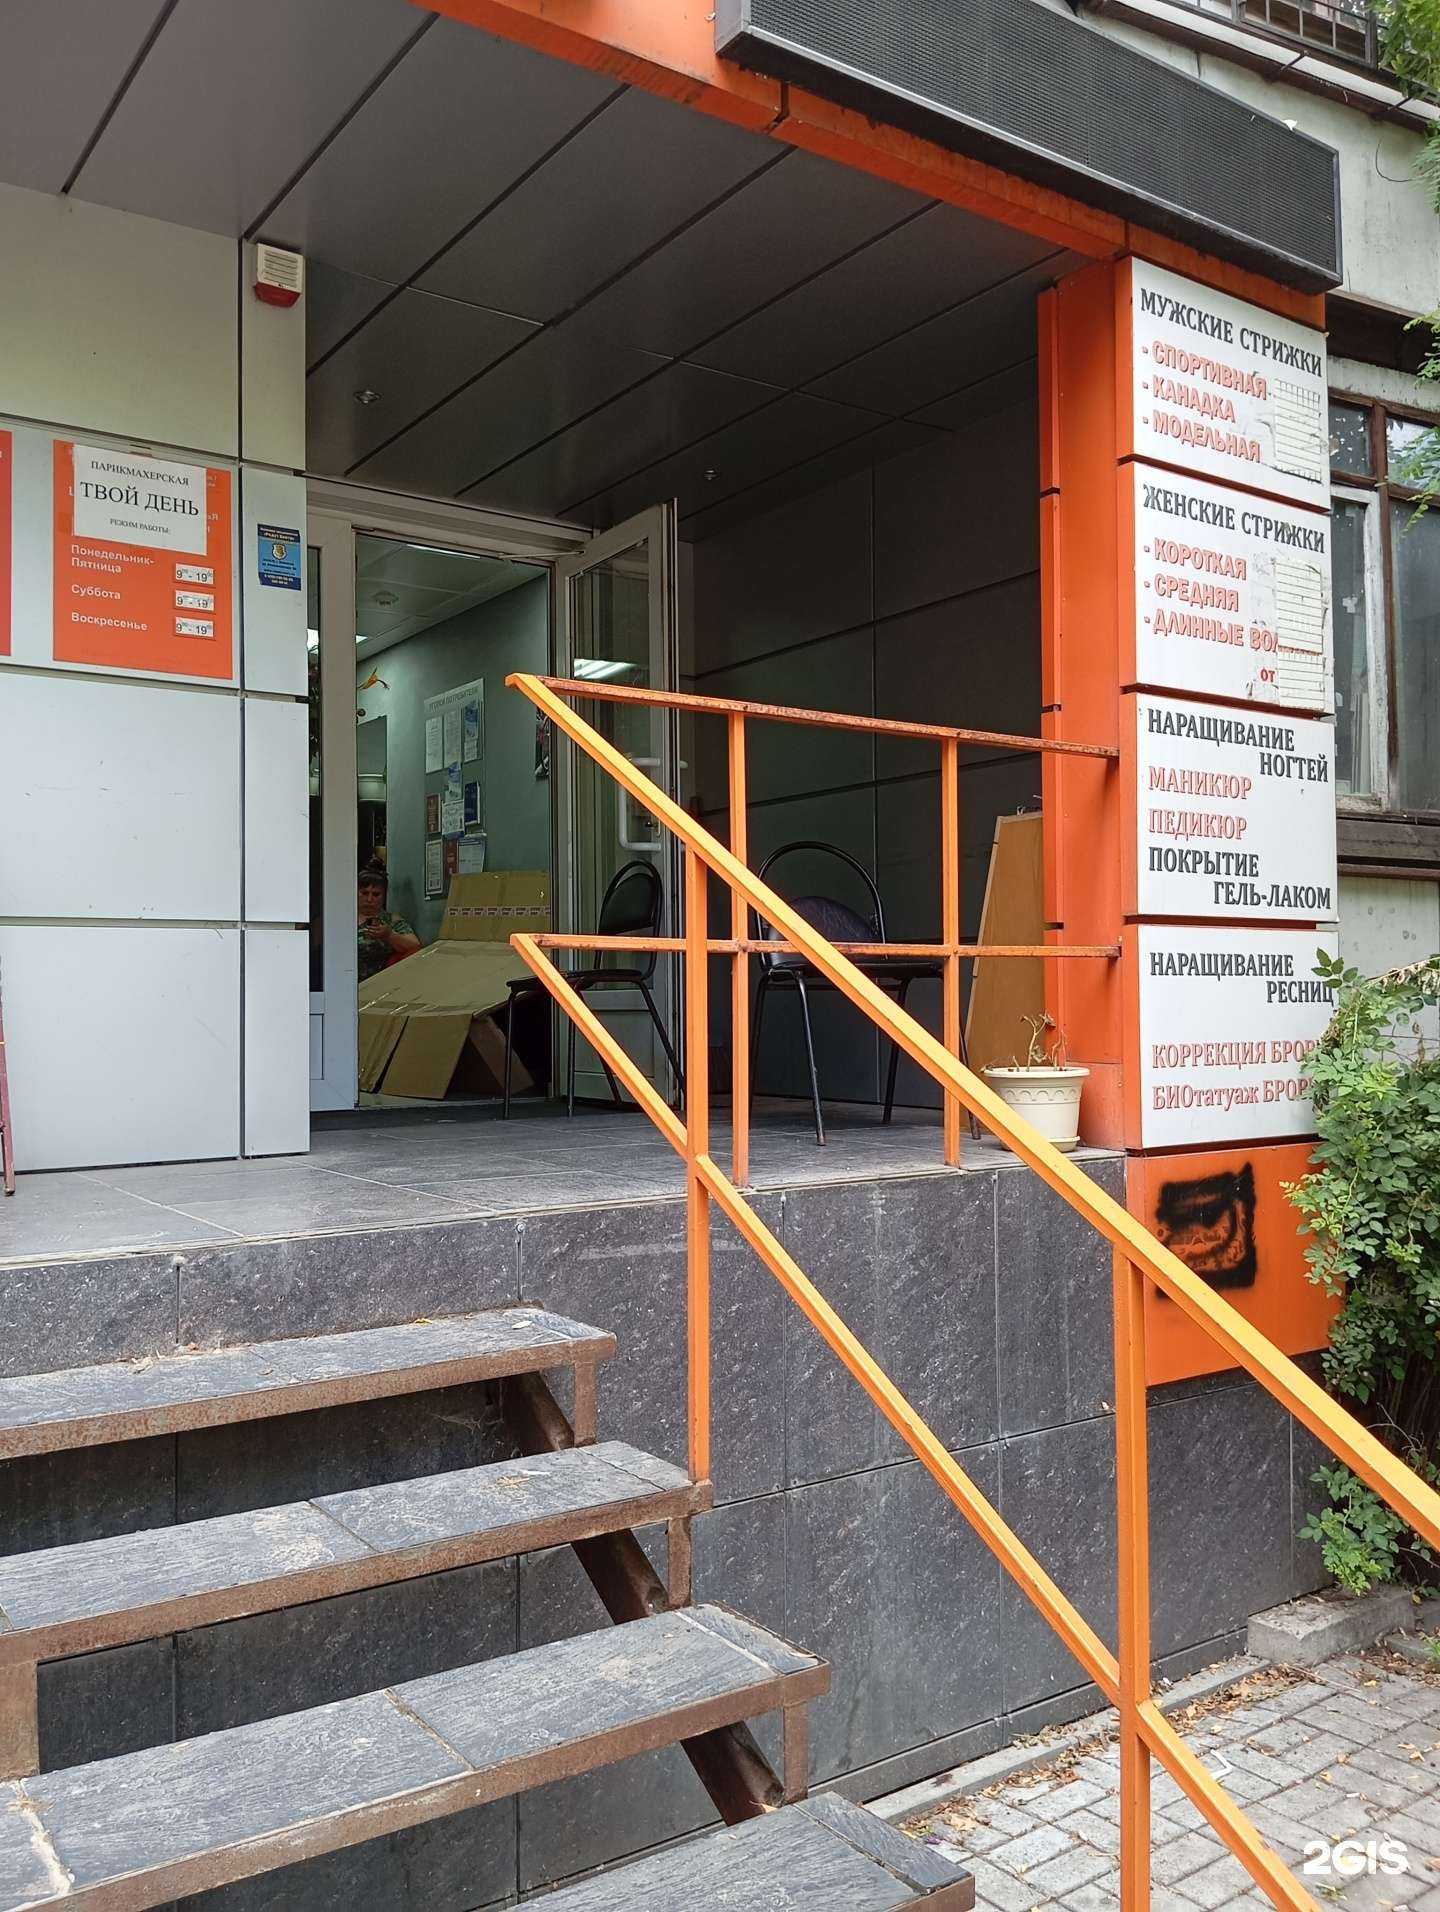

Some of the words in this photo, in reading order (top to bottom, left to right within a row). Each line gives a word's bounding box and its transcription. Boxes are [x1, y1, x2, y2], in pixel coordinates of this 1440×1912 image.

[1140, 287, 1234, 345] МУЖСКИЕ
[1239, 327, 1323, 378] СТРИЖКИ
[1152, 340, 1268, 401] СПОРТИВНАЯ
[1152, 374, 1236, 423] КАНАДКА
[1152, 409, 1261, 463] МОДЕЛЬНАЯ
[91, 460, 190, 486] ПАРИКМАХЕРСКАЯ
[79, 481, 139, 506] ТВОЙ
[144, 493, 200, 516] ДЕНЬ
[110, 518, 138, 528] РЕЖИМ
[1142, 483, 1236, 531] ЖЕНСКИЕ
[1241, 511, 1326, 554] СТРИЖКИ
[71, 544, 155, 566] Понедельник-
[71, 556, 122, 574] Пятница
[1153, 537, 1247, 581] КОРОТКАЯ
[71, 583, 122, 600] Суббота
[1153, 573, 1239, 613] СРЕДНЯЯ
[71, 611, 149, 632] Воскресенье
[1153, 608, 1245, 647] ДЛИННЫЕ
[1148, 707, 1295, 752] НАРАЩИВАНИЕ
[1148, 765, 1253, 800] МАНИКЮР
[1259, 751, 1329, 783] НОГТЕЙ
[1148, 807, 1248, 841] ПЕДИКЮР
[1148, 846, 1260, 877] ПОКРЫТИЕ
[1213, 880, 1332, 910] ГЕЛЬ-ЛАКОМ
[1150, 951, 1295, 981] НАРАЩИВАНИЕ
[1266, 980, 1335, 1007] РЕСНИЦ
[1152, 1040, 1267, 1070] КОРРЕКЦИЯ
[1152, 1084, 1260, 1112] БИОтатуаж
